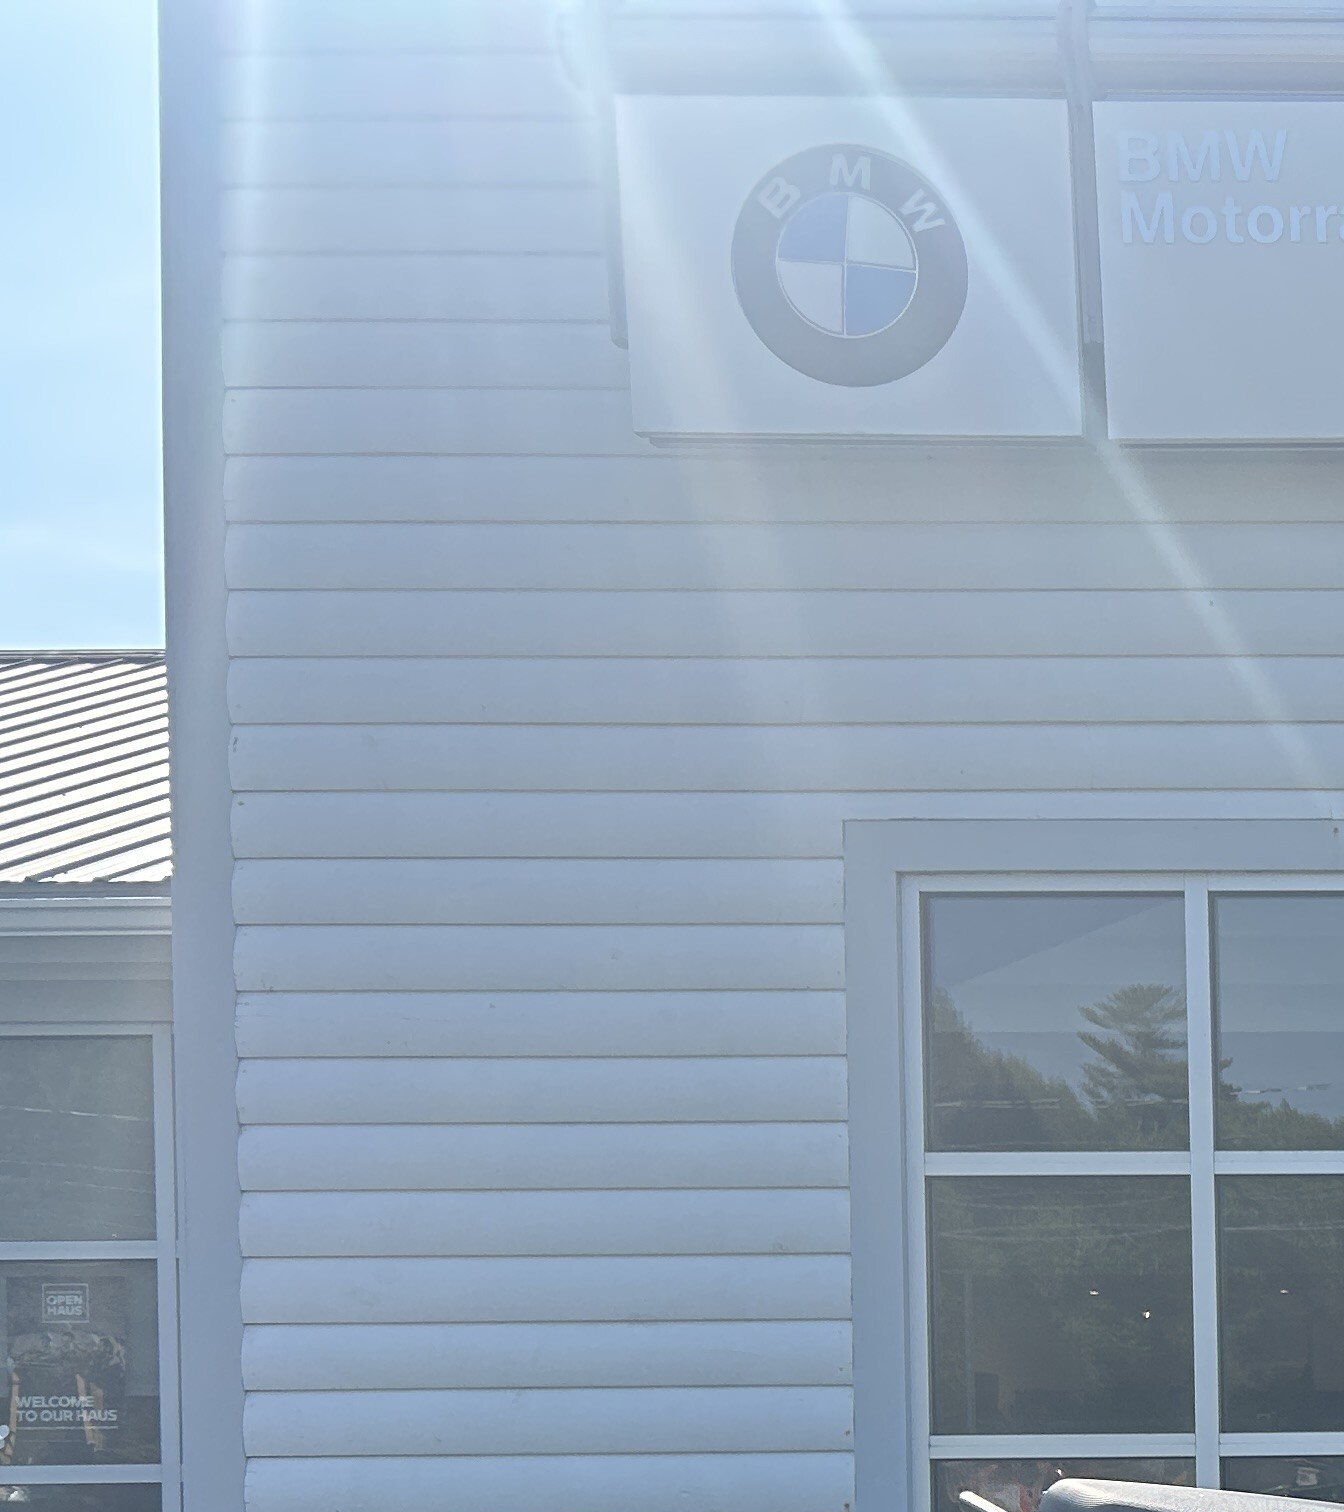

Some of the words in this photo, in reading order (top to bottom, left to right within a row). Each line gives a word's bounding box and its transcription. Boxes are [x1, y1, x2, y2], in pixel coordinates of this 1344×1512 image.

[1116, 129, 1288, 184] BMW
[757, 153, 946, 236] BMW
[46, 1295, 84, 1305] OPEN
[46, 1306, 85, 1316] HAUS
[15, 1395, 95, 1408] WELCOME
[17, 1410, 38, 1422] TO
[40, 1410, 75, 1422] OUR
[76, 1409, 118, 1422] HAUS
